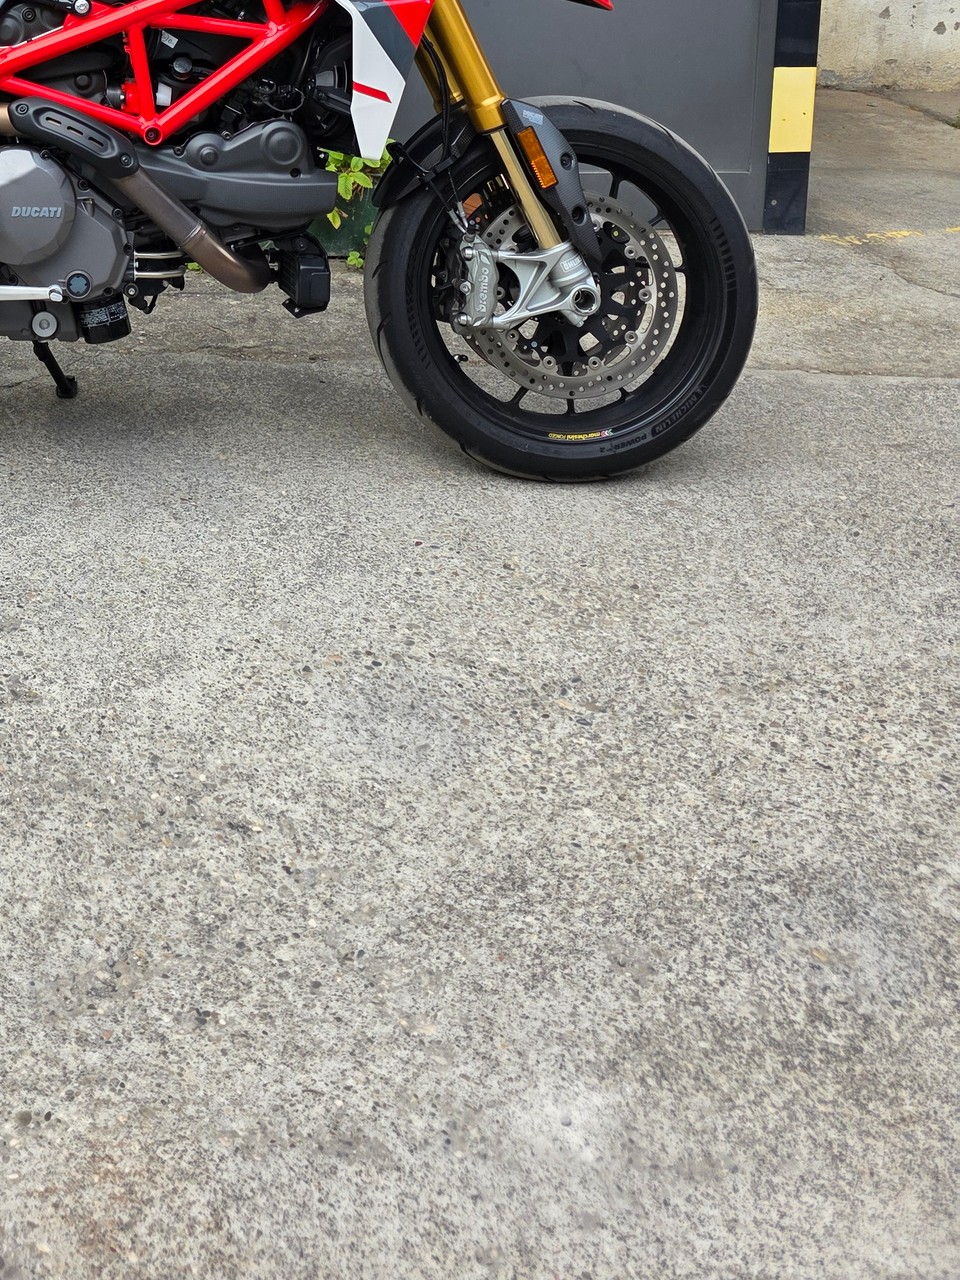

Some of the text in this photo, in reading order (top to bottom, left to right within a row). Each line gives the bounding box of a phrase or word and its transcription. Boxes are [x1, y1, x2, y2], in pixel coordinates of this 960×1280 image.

[11, 206, 62, 218] DUCATI
[477, 268, 489, 313] brembo
[655, 394, 699, 433] MICHELIN
[566, 432, 601, 441] marchesini
[614, 433, 647, 450] POWER
